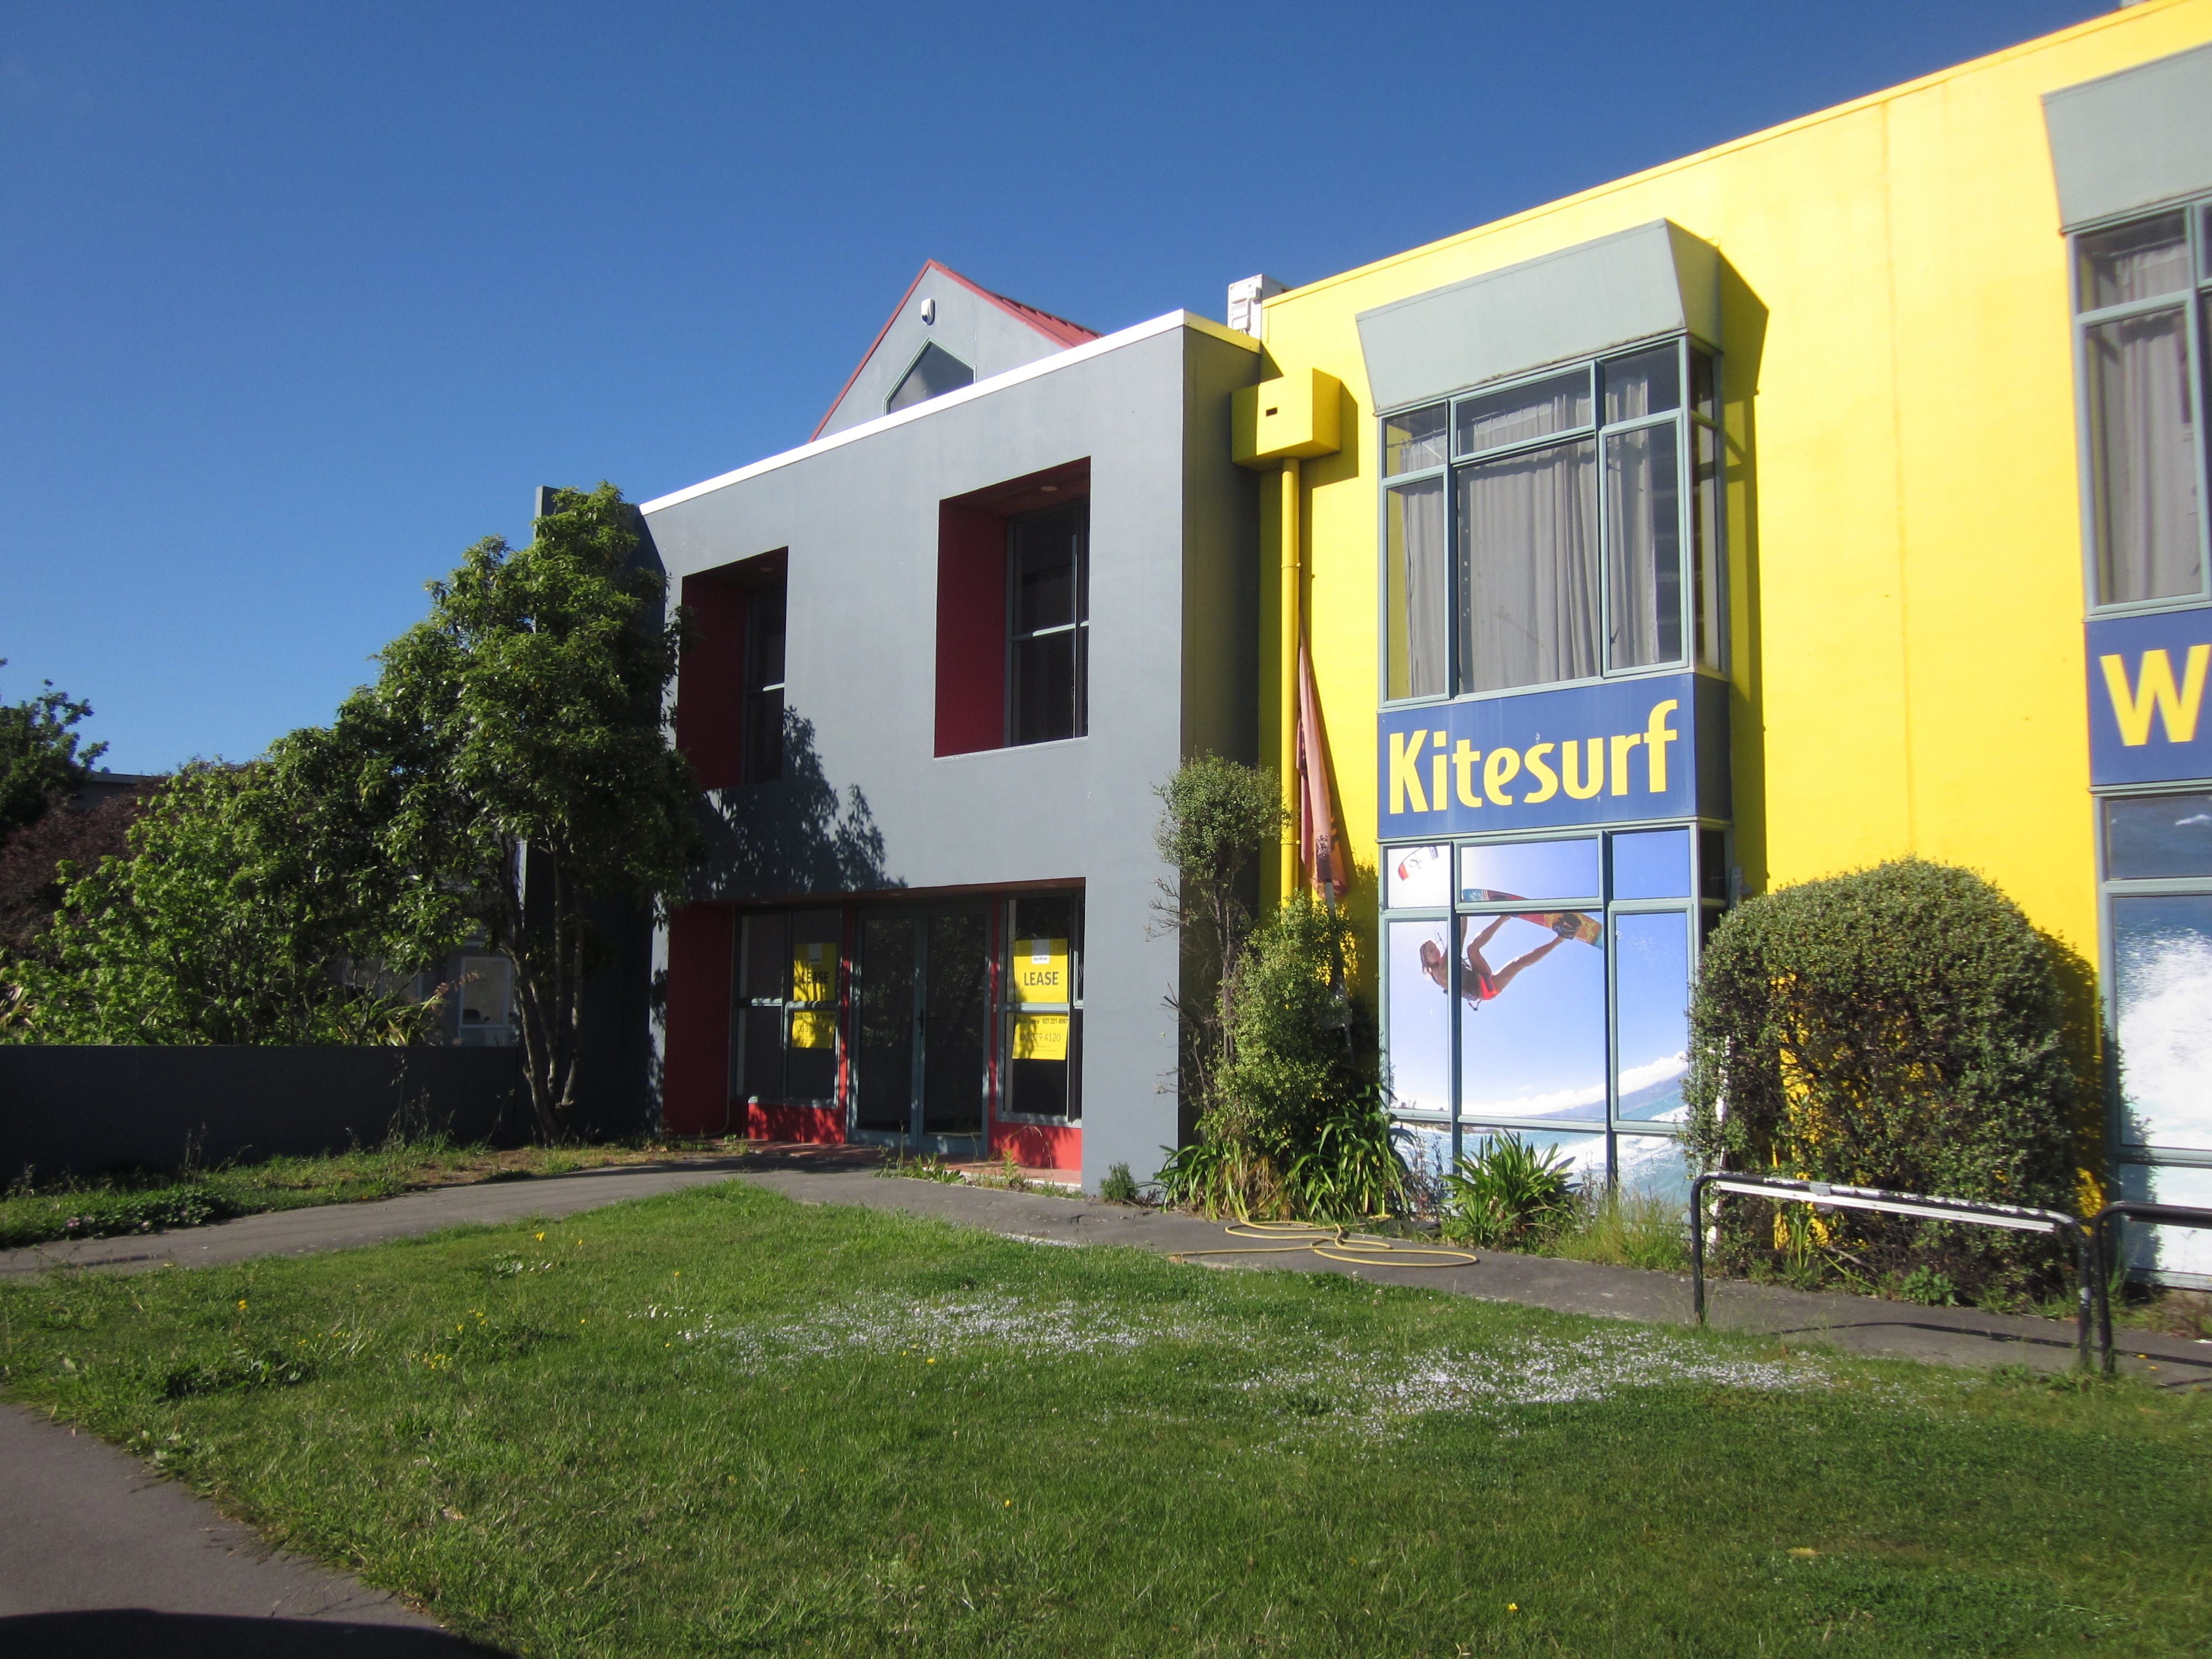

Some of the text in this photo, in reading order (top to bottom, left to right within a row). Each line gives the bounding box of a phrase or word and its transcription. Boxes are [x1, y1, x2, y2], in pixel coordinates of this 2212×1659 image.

[2099, 643, 2212, 747] W
[1389, 698, 1678, 815] Kitesurf
[802, 971, 830, 984] LEASE
[1024, 971, 1059, 986] LEASE
[1020, 1032, 1061, 1042] 03 379 4120
